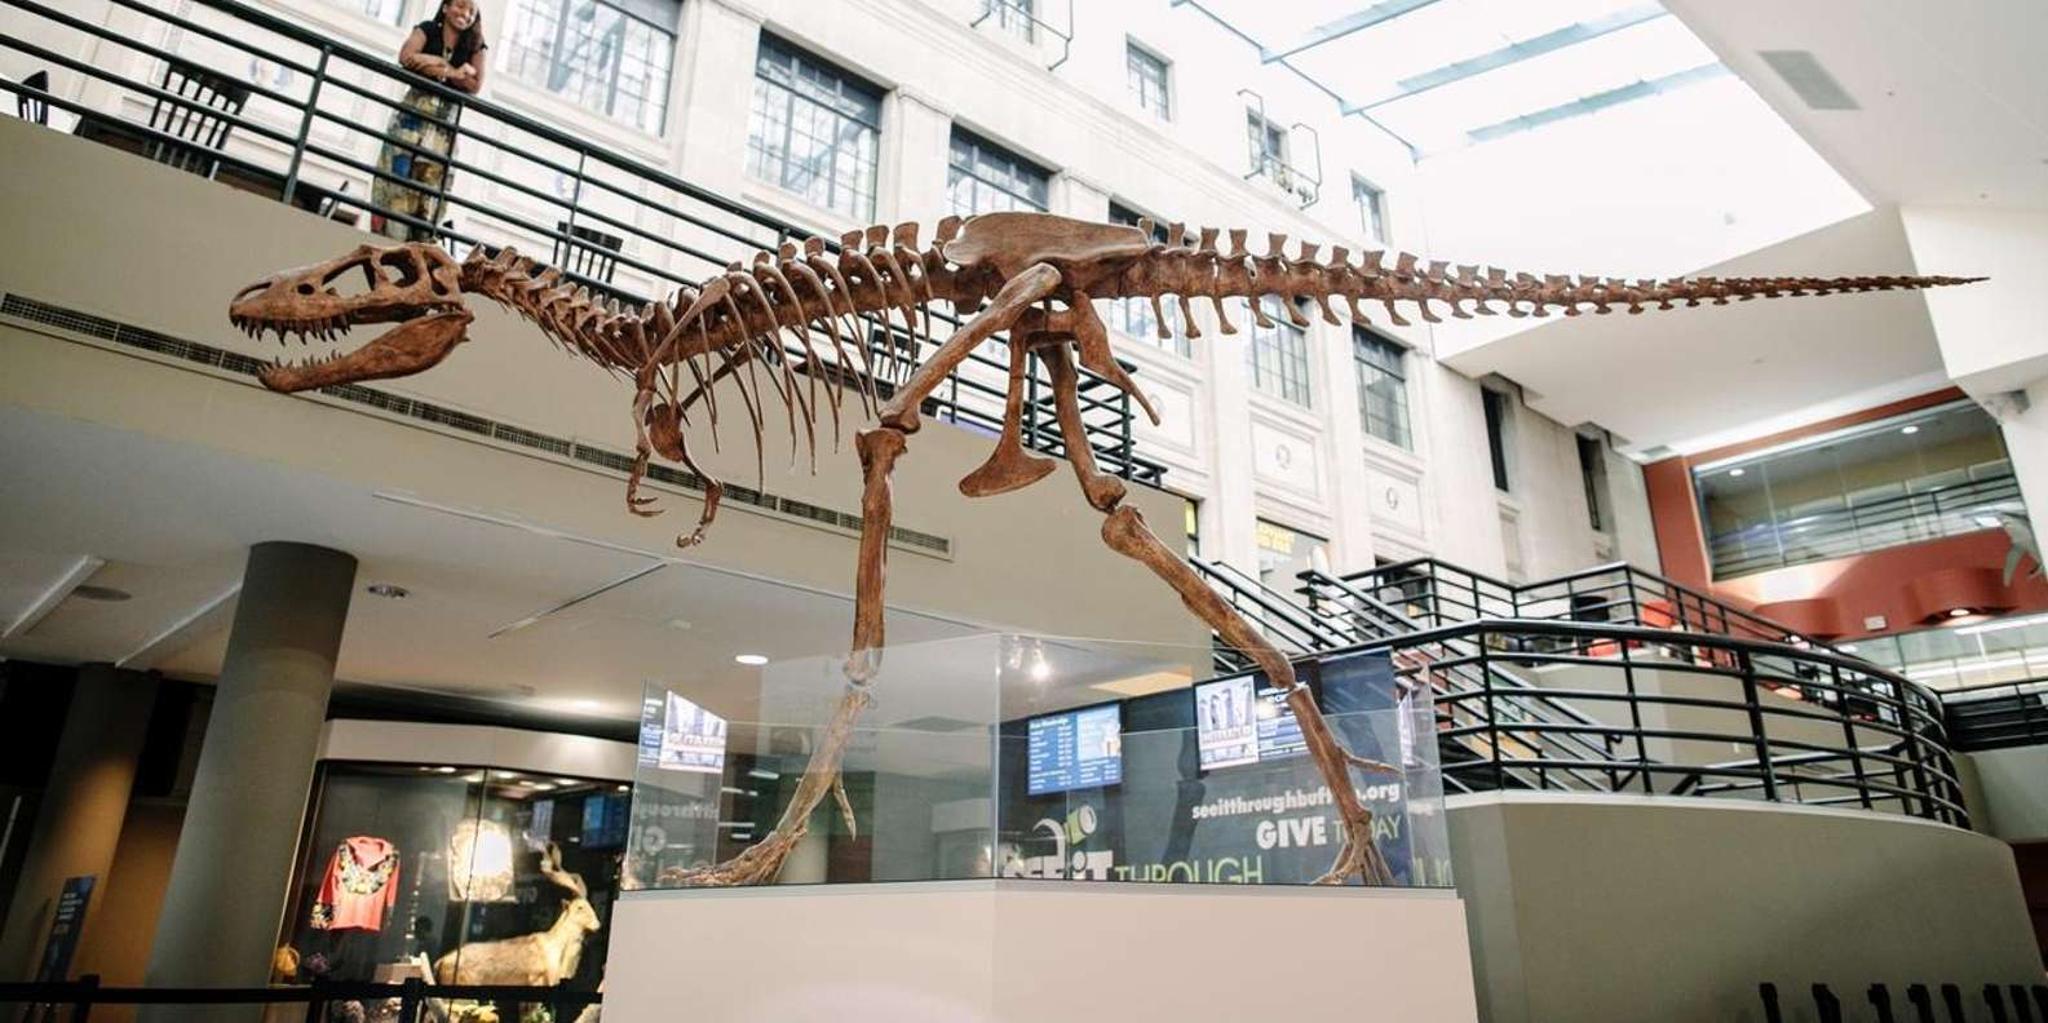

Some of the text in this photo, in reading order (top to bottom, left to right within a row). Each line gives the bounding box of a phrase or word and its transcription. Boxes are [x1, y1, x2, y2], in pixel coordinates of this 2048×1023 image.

[1192, 783, 1400, 819] seeitthroughbuff.org
[1256, 815, 1401, 850] GIVE TAY
